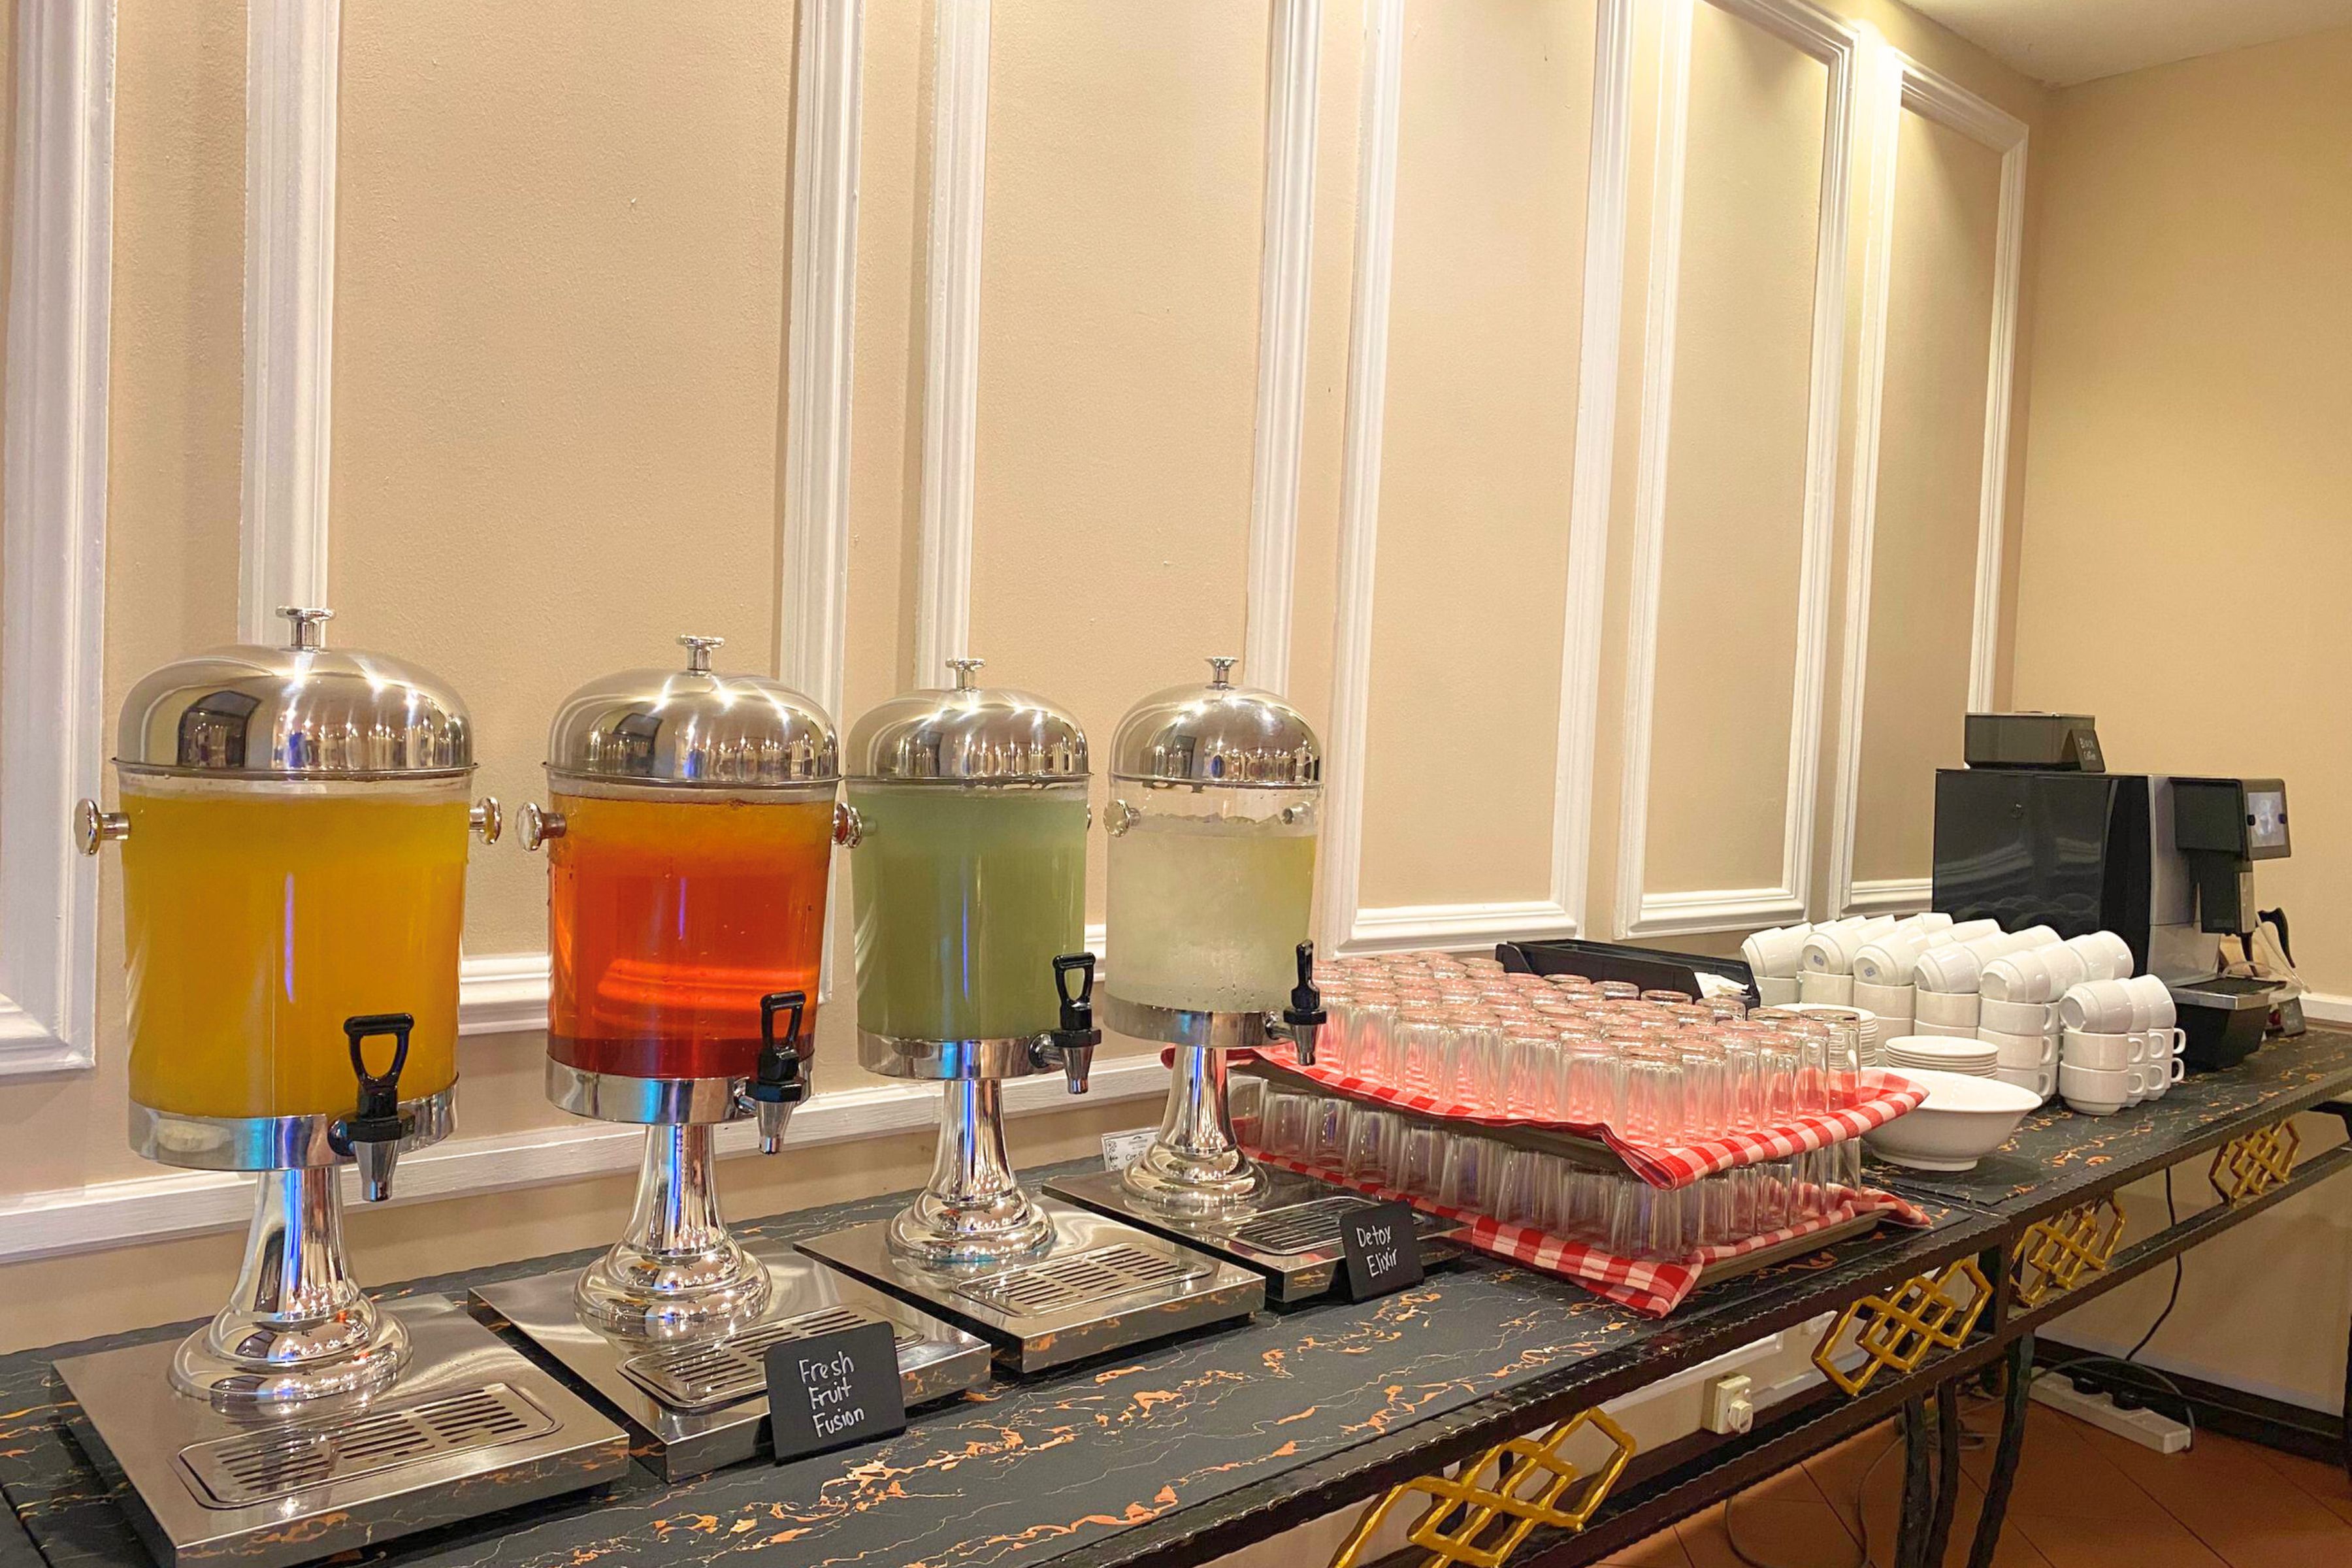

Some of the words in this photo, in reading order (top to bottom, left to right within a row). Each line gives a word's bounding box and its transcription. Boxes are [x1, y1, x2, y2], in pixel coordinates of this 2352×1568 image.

[1356, 1225, 1391, 1248] Detox
[1366, 1247, 1397, 1278] Elixir
[798, 1351, 855, 1384] Fresh
[808, 1377, 853, 1411] Fruit
[812, 1407, 865, 1438] Fusion
